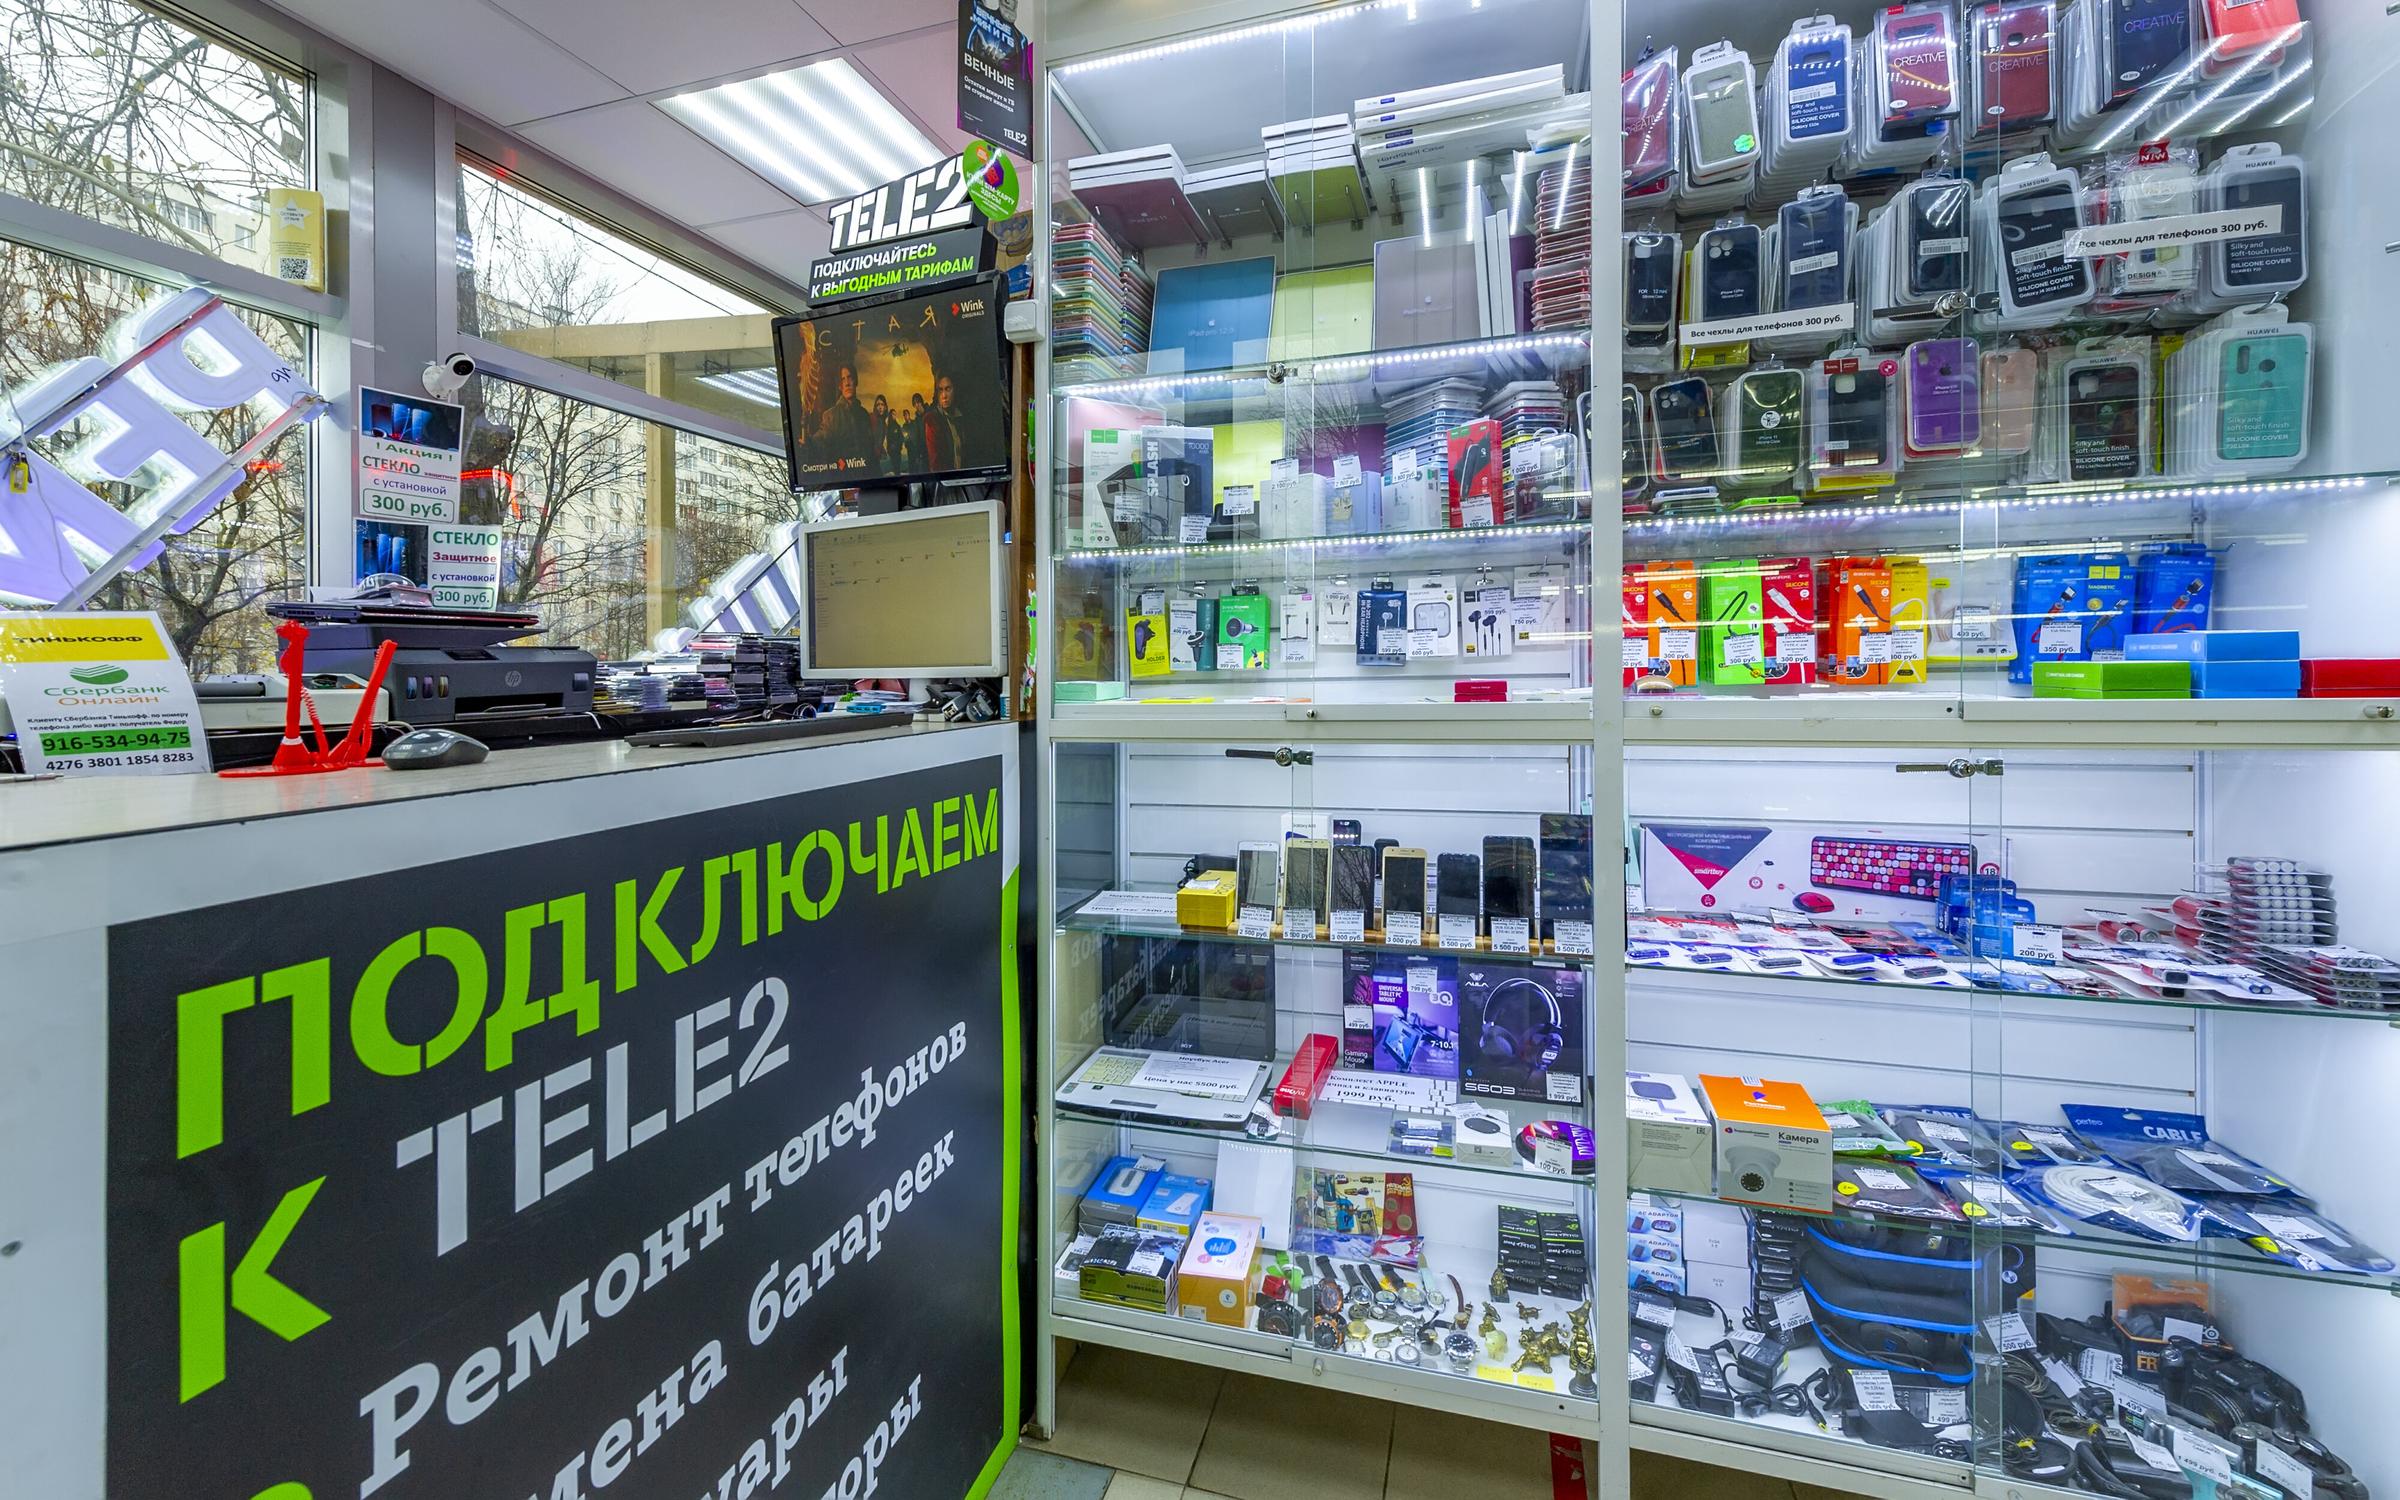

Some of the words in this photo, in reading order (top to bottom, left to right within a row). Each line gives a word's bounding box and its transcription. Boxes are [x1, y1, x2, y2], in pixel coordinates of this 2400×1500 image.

[2123, 11, 2185, 33] CREATIVE
[1894, 50, 1946, 68] CREATIVE
[1989, 54, 2044, 73] CREATIVE
[964, 52, 1015, 91] ВЕЧНЫЕ
[1791, 115, 1818, 124] SILICONE
[1818, 112, 1840, 120] COVER
[1003, 127, 1027, 147] TELE2
[2245, 160, 2276, 169] HUAWEI
[2018, 176, 2050, 188] SAMSUNG
[829, 155, 974, 251] TELE2
[2099, 237, 2132, 246] чехлы
[2134, 235, 2155, 244] для
[2157, 226, 2218, 240] телефонов
[2220, 223, 2241, 233] 300
[2243, 220, 2268, 232] руб.
[2230, 243, 2249, 251] Silky
[2250, 241, 2264, 249] and
[2230, 248, 2269, 258] soft-touch
[2270, 245, 2292, 254] finish
[813, 242, 937, 279] ПОДКЛЮЧАЙТЕСЬ
[2033, 261, 2046, 270] and
[2231, 261, 2264, 269] SILICONE
[2265, 258, 2292, 266] COVER
[810, 285, 821, 299] К
[822, 269, 902, 298] ВЫГОДНЫМ
[904, 255, 975, 282] ТАРИФАМ
[2016, 270, 2052, 282] soft-touch
[2052, 263, 2073, 274] finish
[2018, 280, 2049, 293] SILICONE
[2050, 275, 2074, 286] COVER
[960, 299, 984, 312] Wink
[1690, 330, 1705, 338] Все
[1707, 327, 1735, 336] чехлы
[1735, 326, 1753, 334] для
[1754, 320, 1803, 331] телефонов
[1805, 317, 1822, 326] 300
[1823, 314, 1844, 324] руб.
[2246, 327, 2279, 336] HUAWEI
[2261, 433, 2289, 441] COVER
[385, 443, 444, 461] Акция
[2075, 446, 2110, 454] soft-touch
[2106, 454, 2130, 462] COVER
[362, 455, 421, 475] СТЕКЛО
[802, 462, 829, 473] Смотри
[829, 462, 838, 470] на
[846, 457, 866, 469] Wink
[1147, 440, 1159, 497] SPLASH
[382, 480, 447, 497] установкой
[371, 495, 405, 512] 300
[409, 500, 449, 518] руб.
[432, 531, 499, 546] СТЕКЛО
[432, 551, 498, 563] Защитное
[440, 571, 496, 584] установкой
[435, 590, 460, 602] 300
[463, 591, 490, 604] руб.
[2058, 645, 2075, 654] руб.
[1146, 655, 1166, 663] HOLDER
[43, 685, 170, 698] Сбербанк
[58, 694, 160, 706] Онлайн
[63, 714, 107, 722] Сбербанка
[42, 731, 190, 752] 916-534-94-75
[46, 760, 83, 771] 4276
[88, 757, 122, 768] 3801
[127, 754, 160, 765] 1854
[163, 752, 194, 763] 8283
[1693, 867, 1724, 877] smartbuy
[1255, 932, 1269, 940] руб.
[1348, 934, 1362, 942] руб.
[1405, 938, 1419, 946] руб.
[1459, 942, 1473, 950] руб.
[1512, 945, 1528, 953] руб.
[1576, 946, 1592, 955] руб.
[2019, 949, 2035, 957] 200
[2037, 950, 2057, 960] руб.
[176, 787, 1000, 1160] ПОДКЛЮЧАЕМ
[1378, 985, 1404, 993] UNIVERSAL
[1179, 1056, 1210, 1064] Ноутбук
[1344, 1049, 1368, 1060] Gaming
[1344, 1056, 1365, 1064] Mouse
[1144, 1076, 1168, 1084] Цена
[1330, 1075, 1373, 1084] Комплект
[1377, 1079, 1409, 1087] APPLE
[1465, 1082, 1516, 1096] S603
[1337, 1090, 1365, 1098] 1999
[1368, 1095, 1395, 1103] руб.
[2075, 1117, 2104, 1126] perfeo
[1777, 1131, 1820, 1145] Камера
[2143, 1125, 2203, 1143] CABLE
[1539, 1162, 1551, 1170] 100
[1551, 1165, 1567, 1175] руб.
[178, 1175, 334, 1405] К
[396, 977, 790, 1258] TELE2
[745, 1128, 956, 1347] батареек
[1648, 1240, 1679, 1248] ADAPTOR
[359, 1184, 730, 1500] Ремонт
[746, 1019, 969, 1214] телефонов
[1651, 1271, 1683, 1280] ADAPTOR
